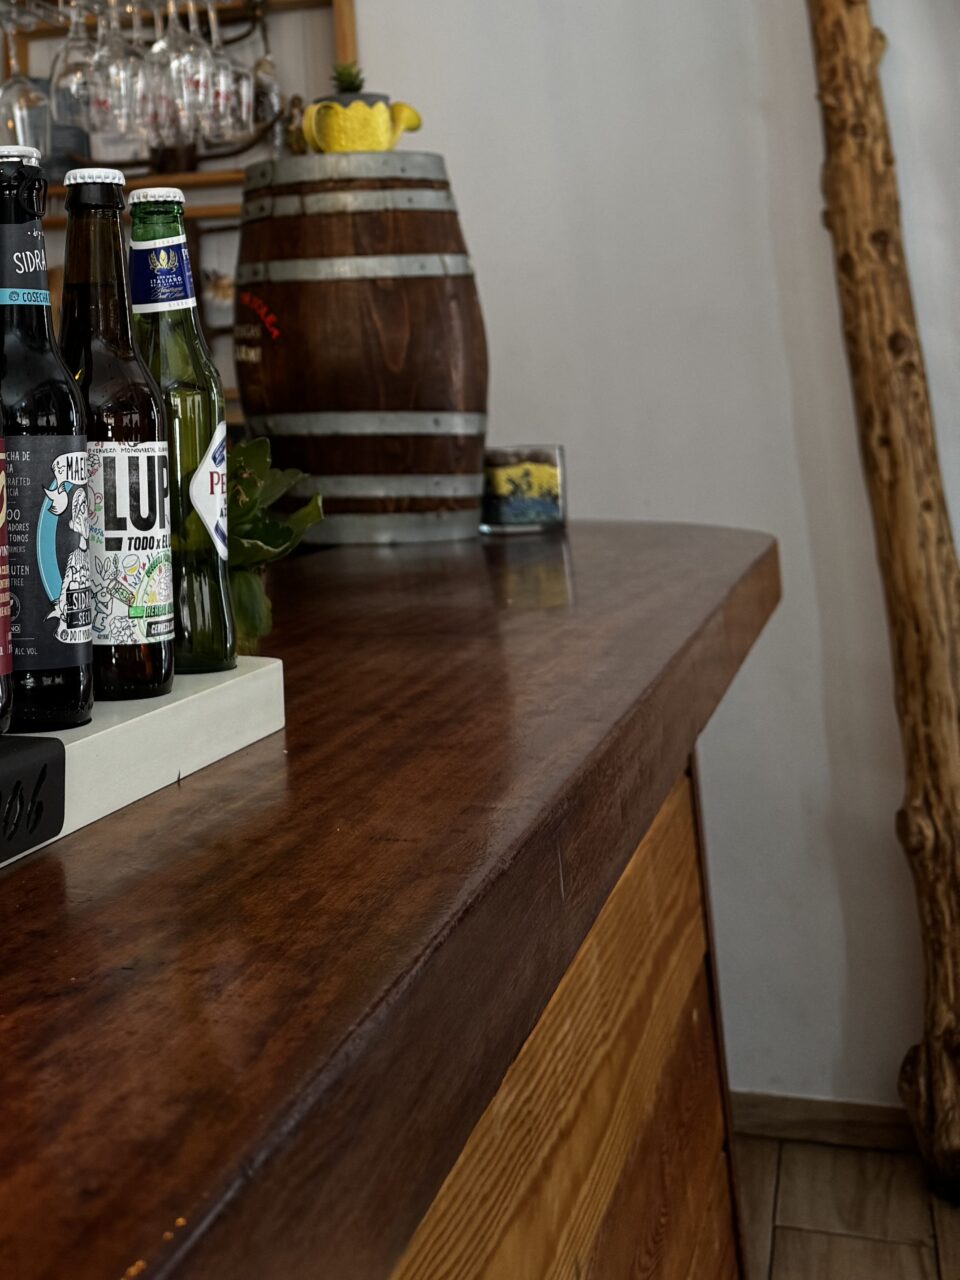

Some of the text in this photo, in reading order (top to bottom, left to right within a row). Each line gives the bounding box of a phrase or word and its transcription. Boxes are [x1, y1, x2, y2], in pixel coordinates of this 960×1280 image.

[6, 451, 31, 461] CHA DE
[7, 477, 31, 486] RAFTED
[102, 455, 169, 531] LUP
[8, 522, 30, 531] ADORES
[9, 533, 29, 543] TONOS
[127, 535, 155, 551] TODO
[10, 564, 30, 576] UTEN
